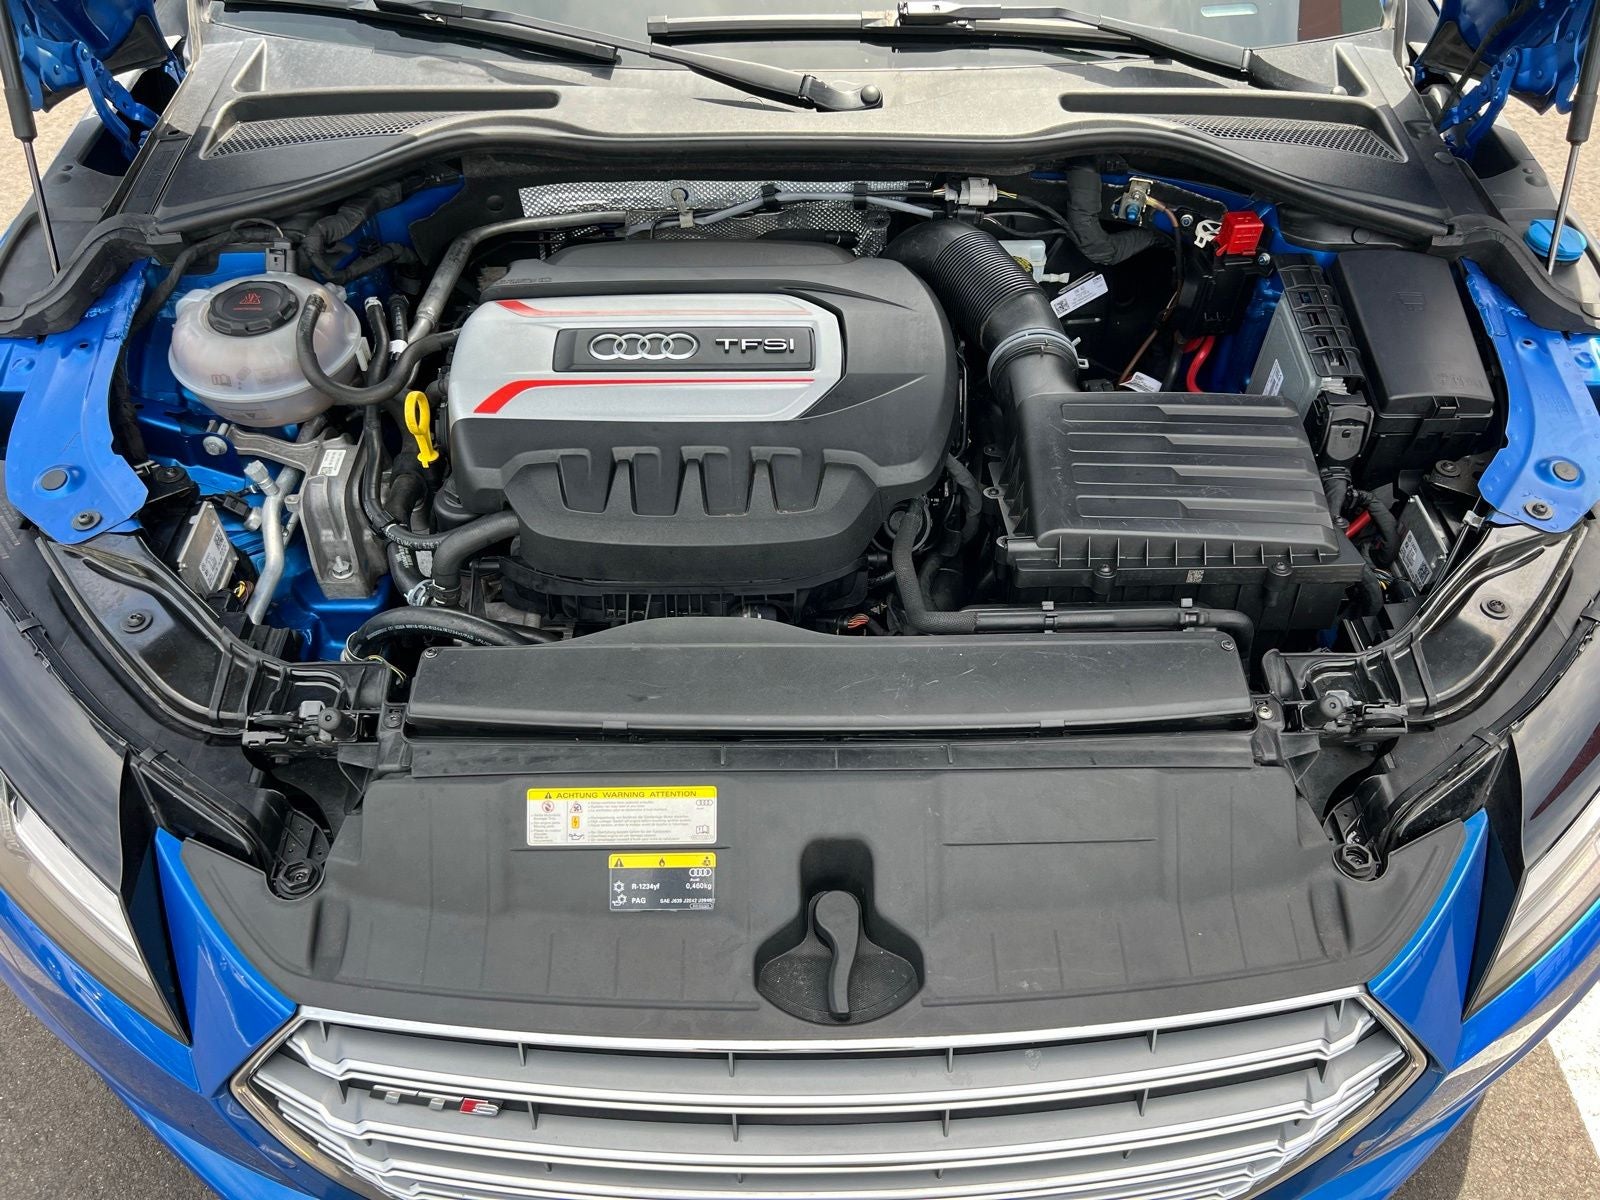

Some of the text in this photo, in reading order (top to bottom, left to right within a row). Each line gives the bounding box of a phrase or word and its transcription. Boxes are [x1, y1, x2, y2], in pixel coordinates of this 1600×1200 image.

[715, 338, 795, 353] TFSI
[650, 790, 697, 798] ATTENTION
[631, 882, 712, 891] R-1234yf 0,460kg
